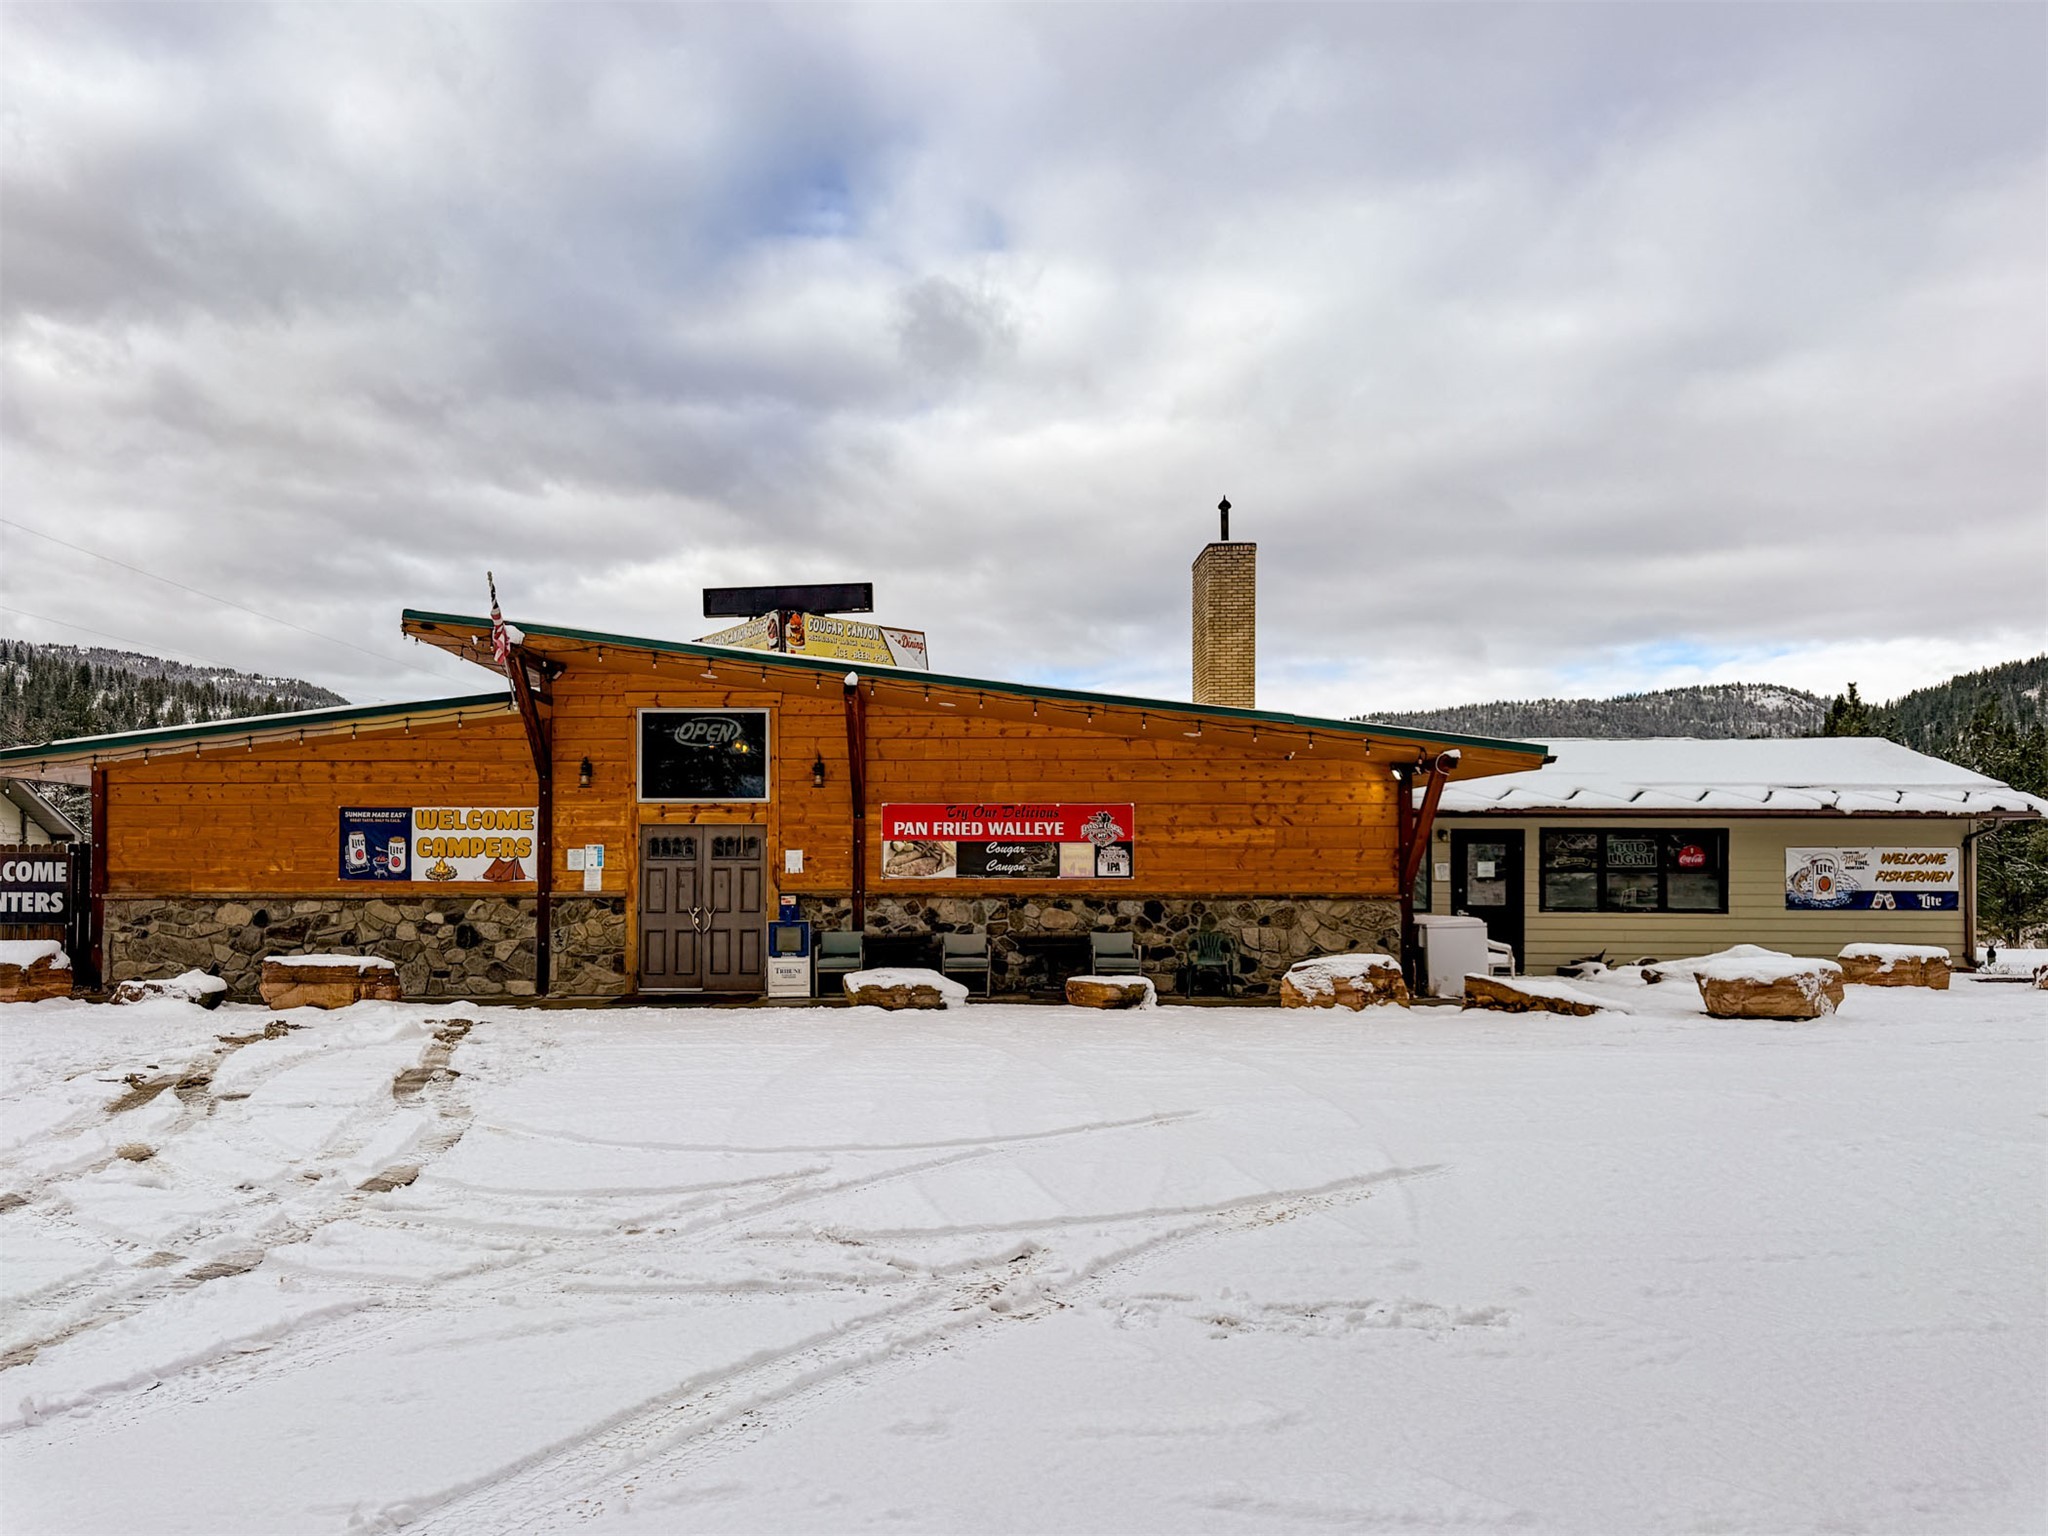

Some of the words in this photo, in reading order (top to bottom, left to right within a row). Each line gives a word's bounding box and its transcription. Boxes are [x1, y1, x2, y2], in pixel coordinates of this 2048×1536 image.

[808, 617, 844, 637] COUGAR
[846, 624, 880, 641] CANYON
[902, 634, 924, 655] Dining
[836, 647, 848, 659] ICE
[679, 722, 734, 742] OPEN
[415, 809, 534, 830] WELCOME
[946, 805, 968, 820] Try
[973, 805, 997, 818] Our
[1001, 805, 1059, 818] Delicious
[894, 821, 930, 836] PAN
[933, 821, 983, 836] FRIED
[988, 821, 1064, 836] WALLEYE
[352, 839, 365, 849] Lite
[390, 846, 404, 856] Lite
[416, 837, 532, 858] CAMPERS
[986, 841, 1026, 857] Cougar
[1614, 841, 1648, 853] BUD
[986, 859, 1026, 875] Canyon
[1107, 862, 1121, 872] IPA
[1609, 853, 1655, 866] LIGHT
[1880, 853, 1949, 866] WELCOME
[0, 861, 67, 883] COME
[1816, 864, 1833, 876] Lite
[1875, 870, 1954, 883] FISHERMEN
[1917, 893, 1943, 909] Lite
[775, 967, 802, 975] TRIBUNE
